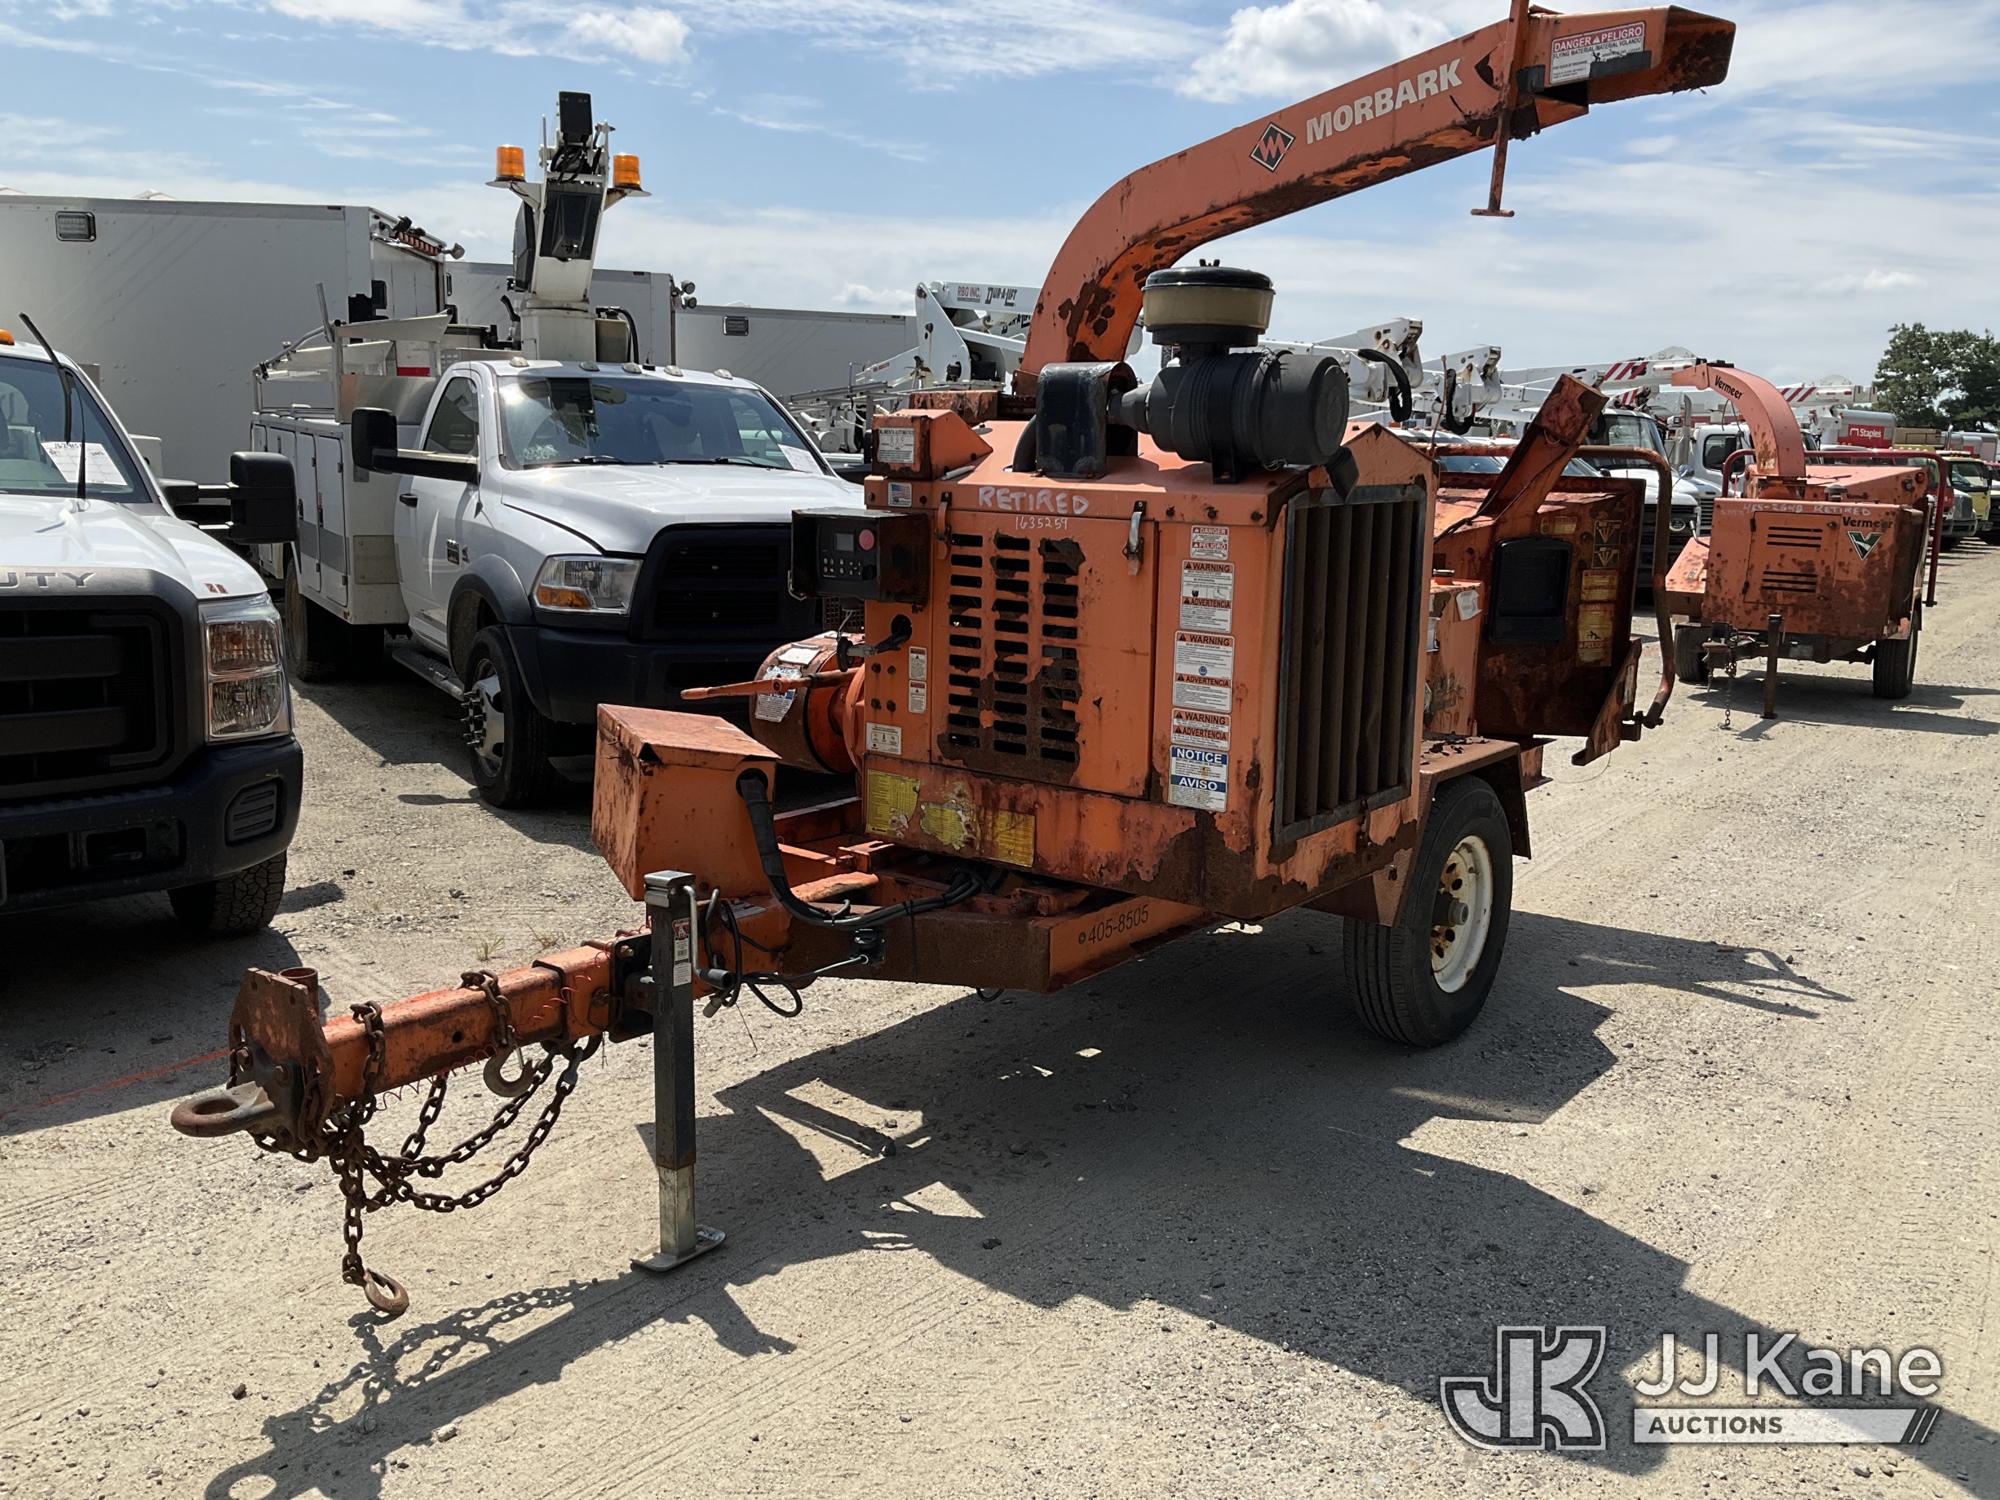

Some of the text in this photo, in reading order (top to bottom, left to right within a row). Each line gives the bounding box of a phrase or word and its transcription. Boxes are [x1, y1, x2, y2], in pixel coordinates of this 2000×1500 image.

[1554, 26, 1642, 52] DANGER PELIGRO
[1553, 49, 1571, 59] FLYING
[1306, 58, 1462, 145] MORBARK
[1715, 374, 1743, 400] Vermeer
[1858, 429, 1882, 440] Staples
[978, 486, 1090, 515] RETIRED
[1813, 502, 1872, 516] RETIRED
[1015, 516, 1068, 531] 1635259
[1200, 527, 1226, 535] DANGER
[1199, 542, 1225, 550] PELIGRO
[1193, 562, 1231, 573] WARNING
[1190, 598, 1231, 609] ADVERTENCIA
[1190, 634, 1230, 646] WARNING
[1186, 675, 1229, 687] ADVERTENCIA
[1185, 711, 1226, 725] WARNING
[1182, 727, 1227, 740] ADVERTENCIA
[1176, 748, 1222, 764] NOTICE
[1179, 777, 1218, 791] AVISO
[1088, 904, 1149, 944] 405-8505
